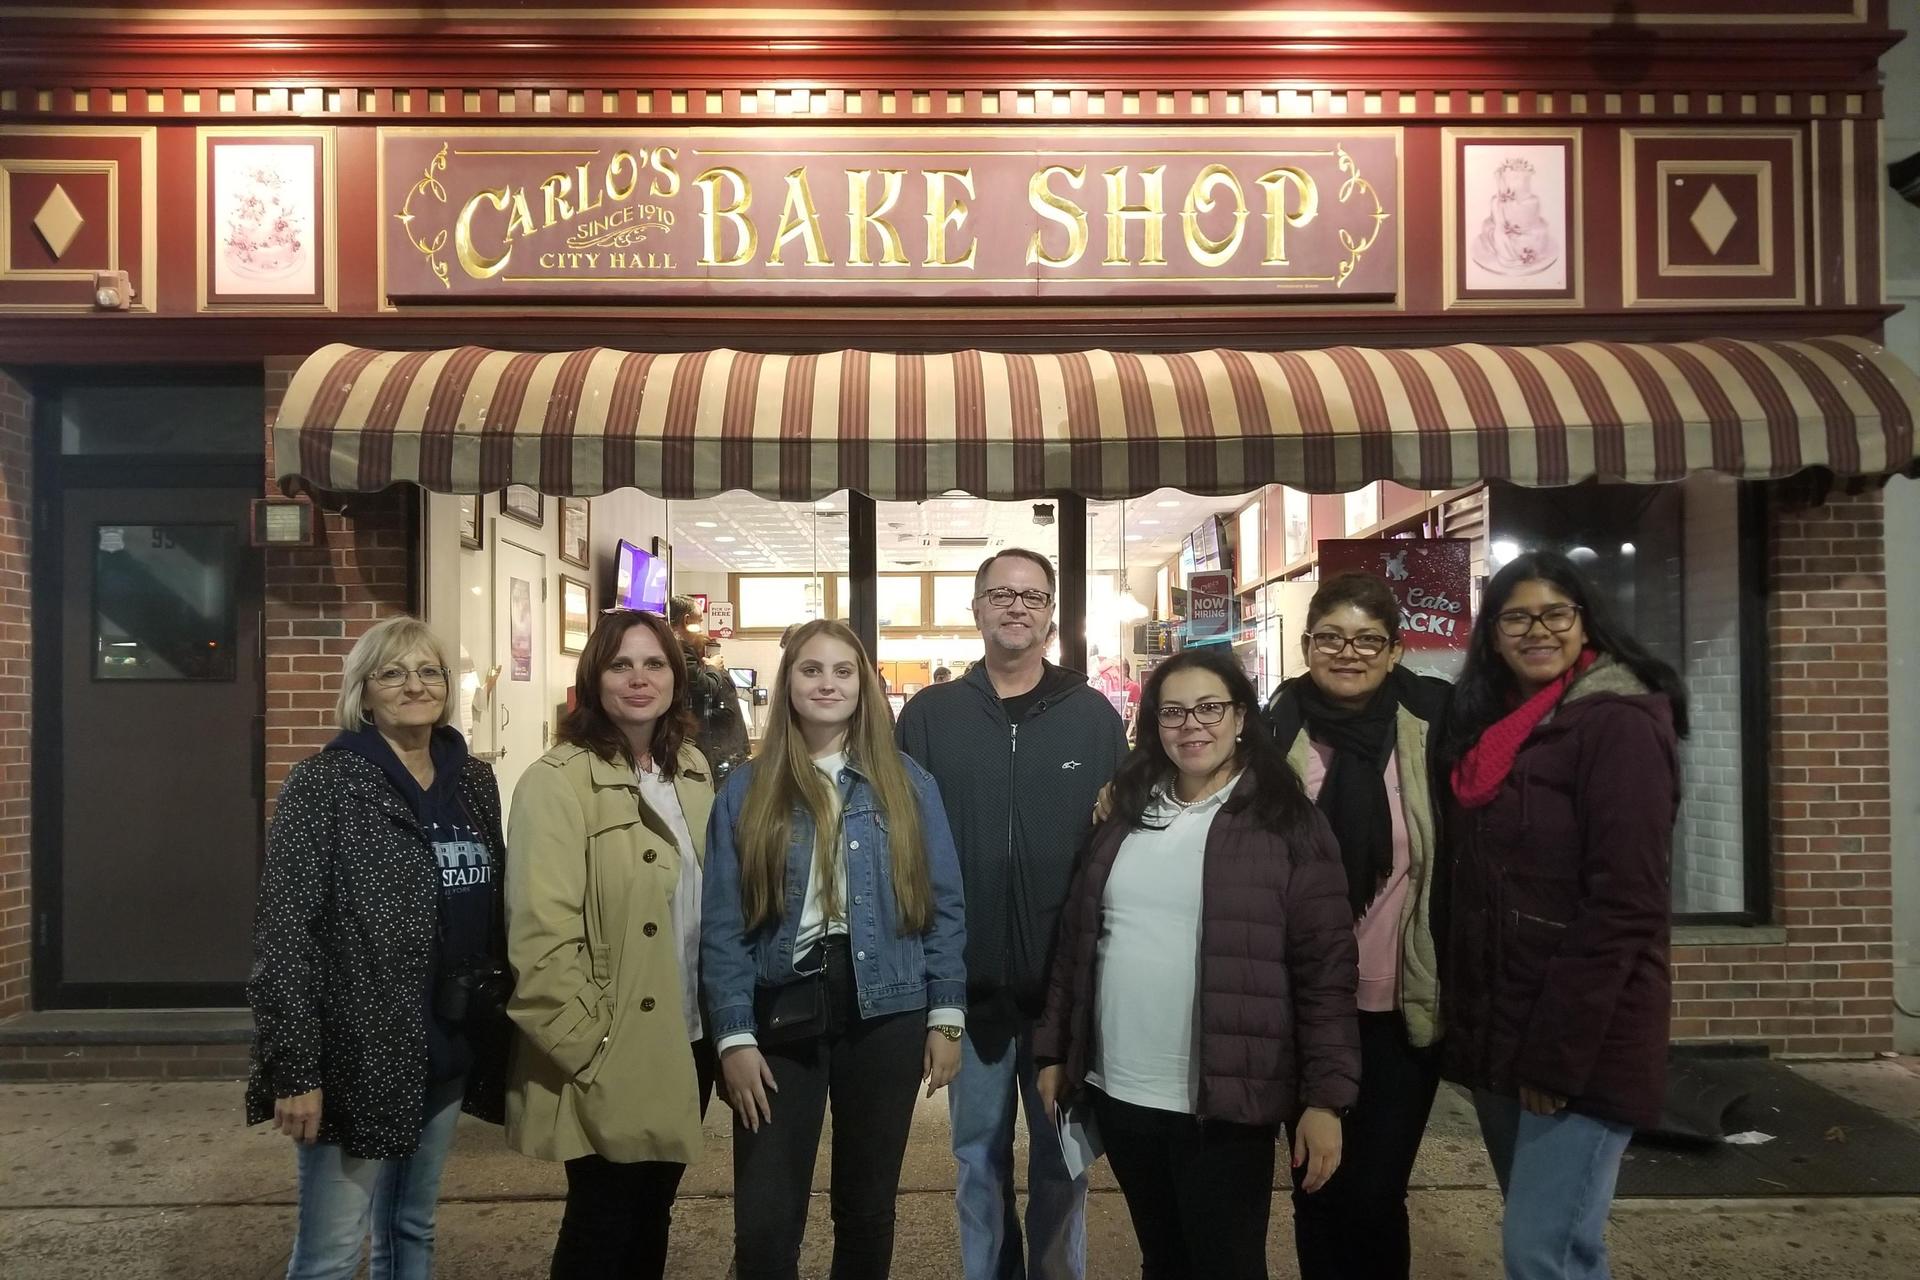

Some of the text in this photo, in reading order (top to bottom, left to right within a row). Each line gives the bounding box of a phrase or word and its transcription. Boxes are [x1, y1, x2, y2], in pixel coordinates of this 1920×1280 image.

[455, 146, 1319, 279] CARLO'S BAKE SHOP
[577, 203, 675, 239] SINCE 1910
[540, 252, 677, 269] CITY HALL
[1194, 597, 1226, 610] NOW
[1406, 587, 1462, 614] Cake
[1194, 609, 1226, 619] HIRING
